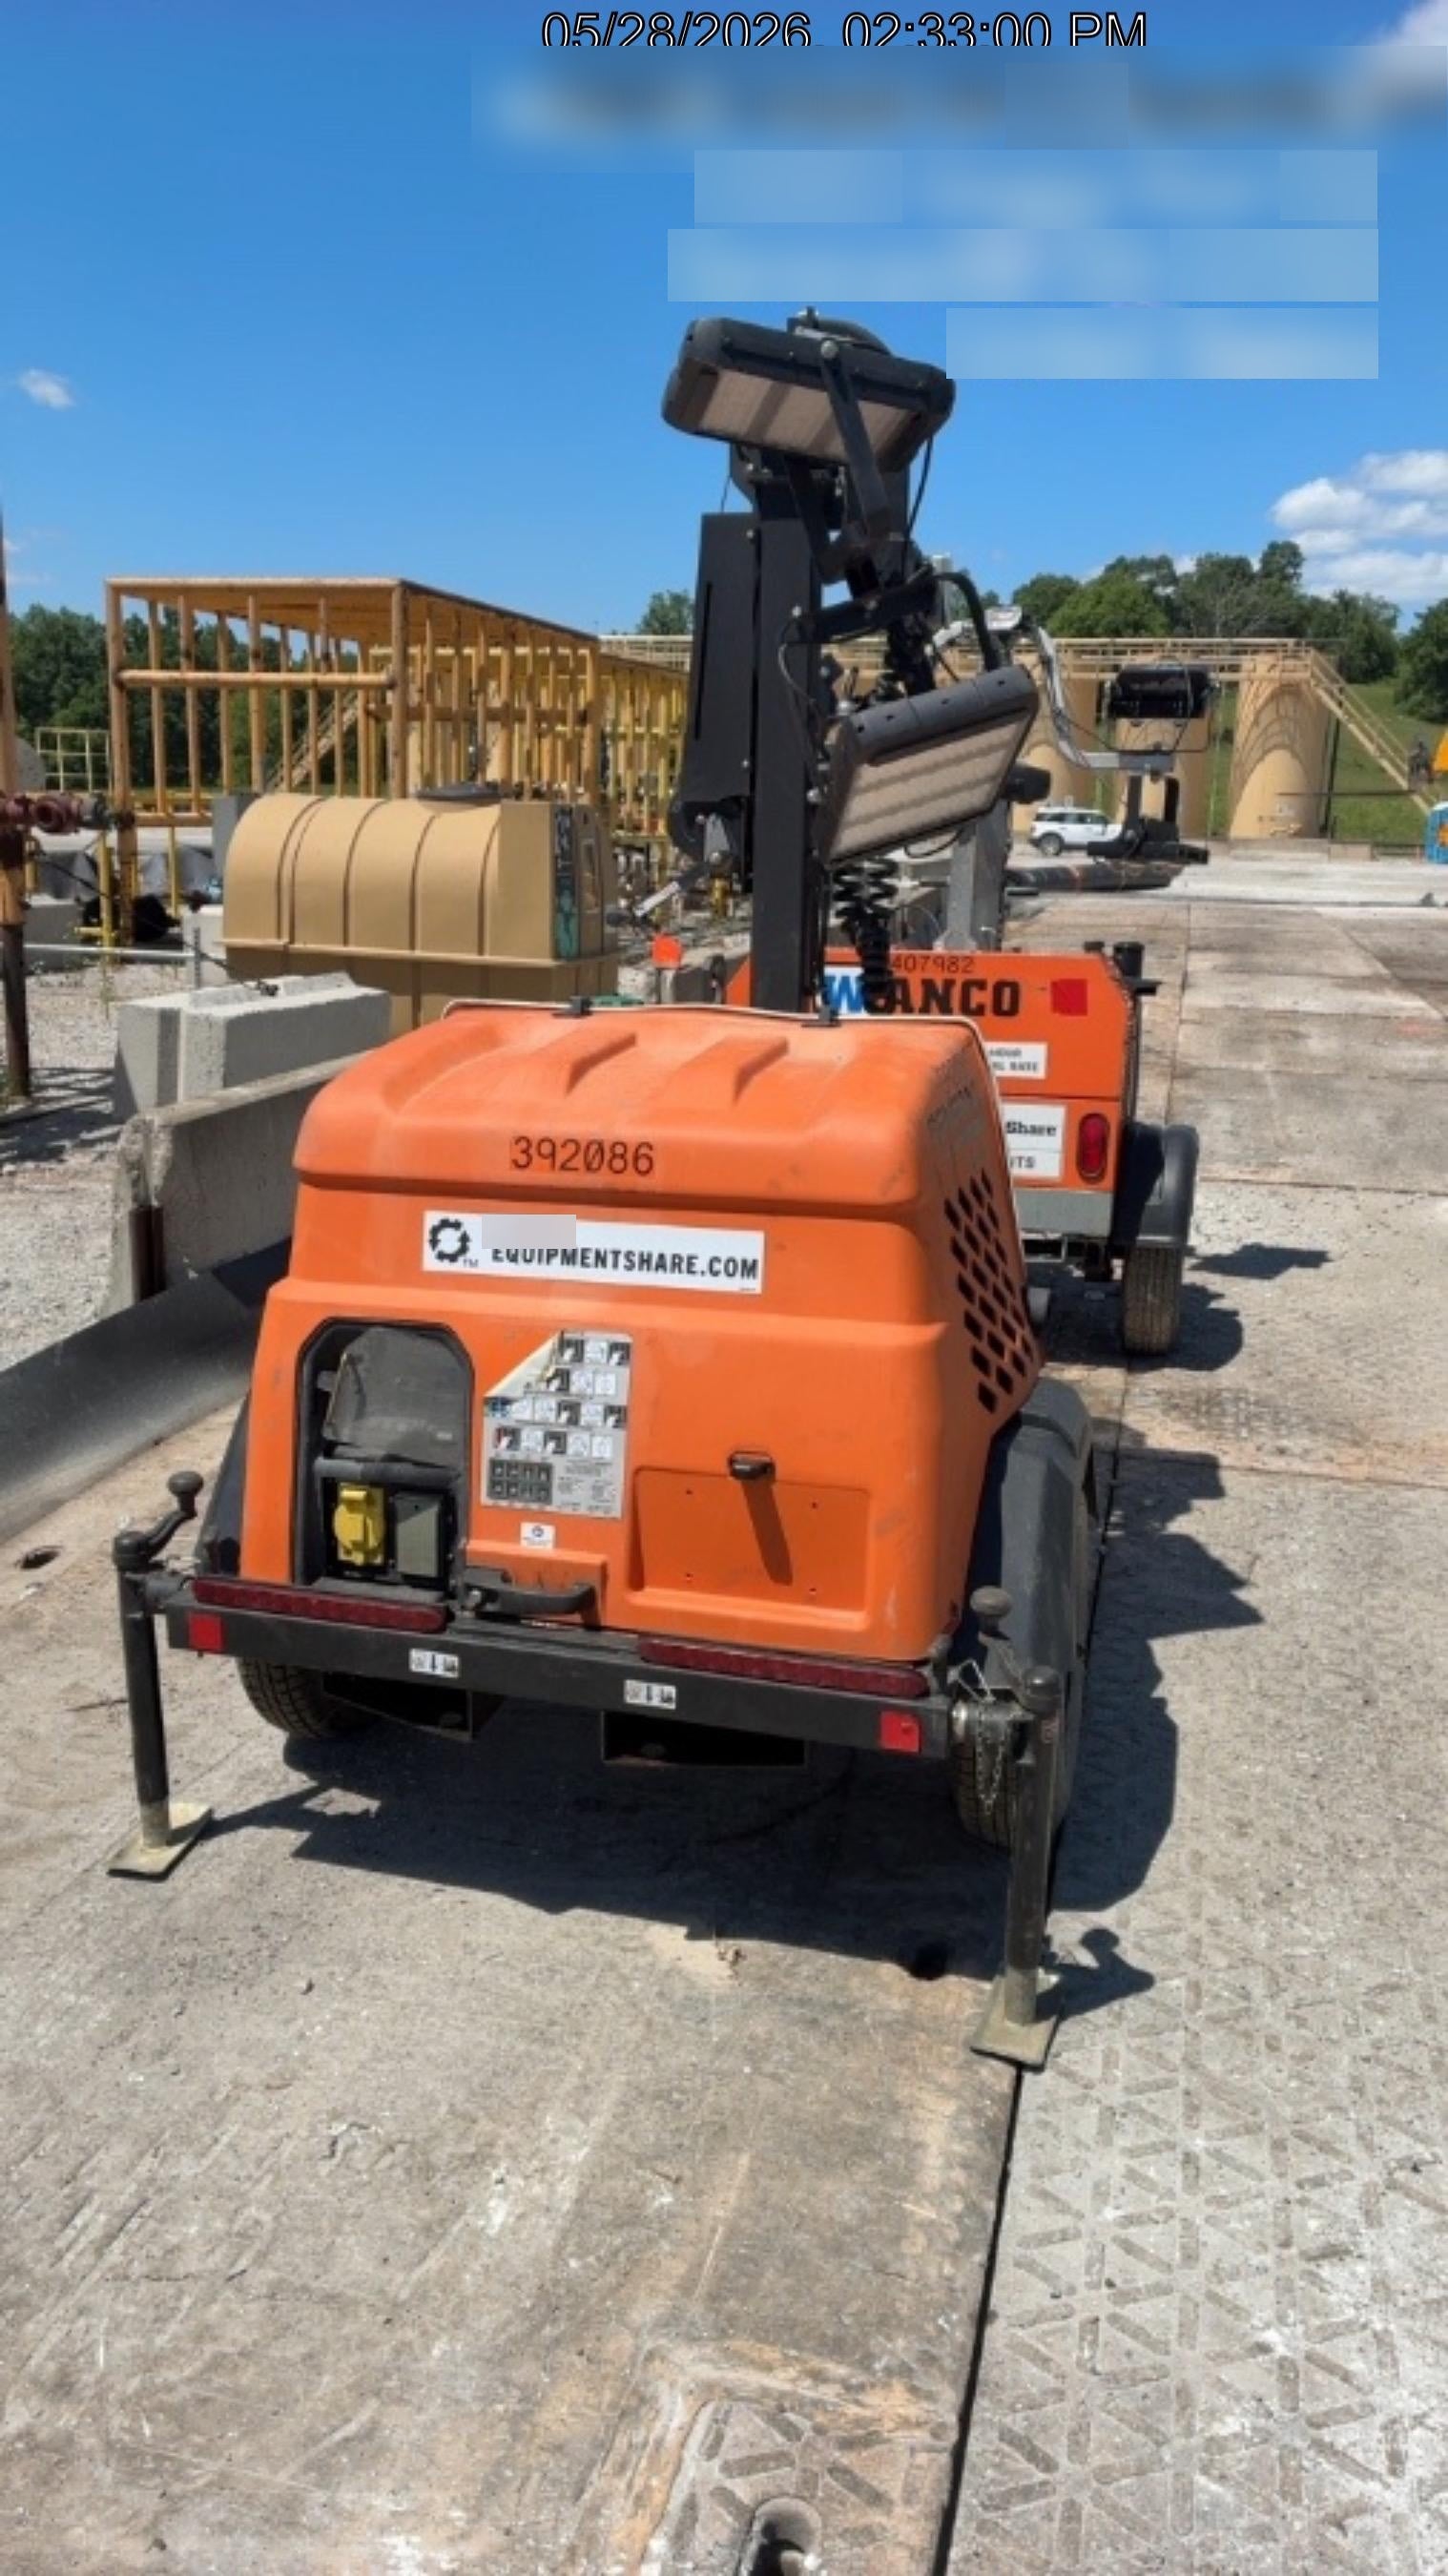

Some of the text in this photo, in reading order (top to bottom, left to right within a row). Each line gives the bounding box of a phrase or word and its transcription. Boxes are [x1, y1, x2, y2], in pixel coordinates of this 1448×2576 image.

[893, 955, 975, 974] 407982
[511, 1135, 653, 1176] 392086
[491, 1247, 759, 1280] EQUIPMENTSHARE.COM
